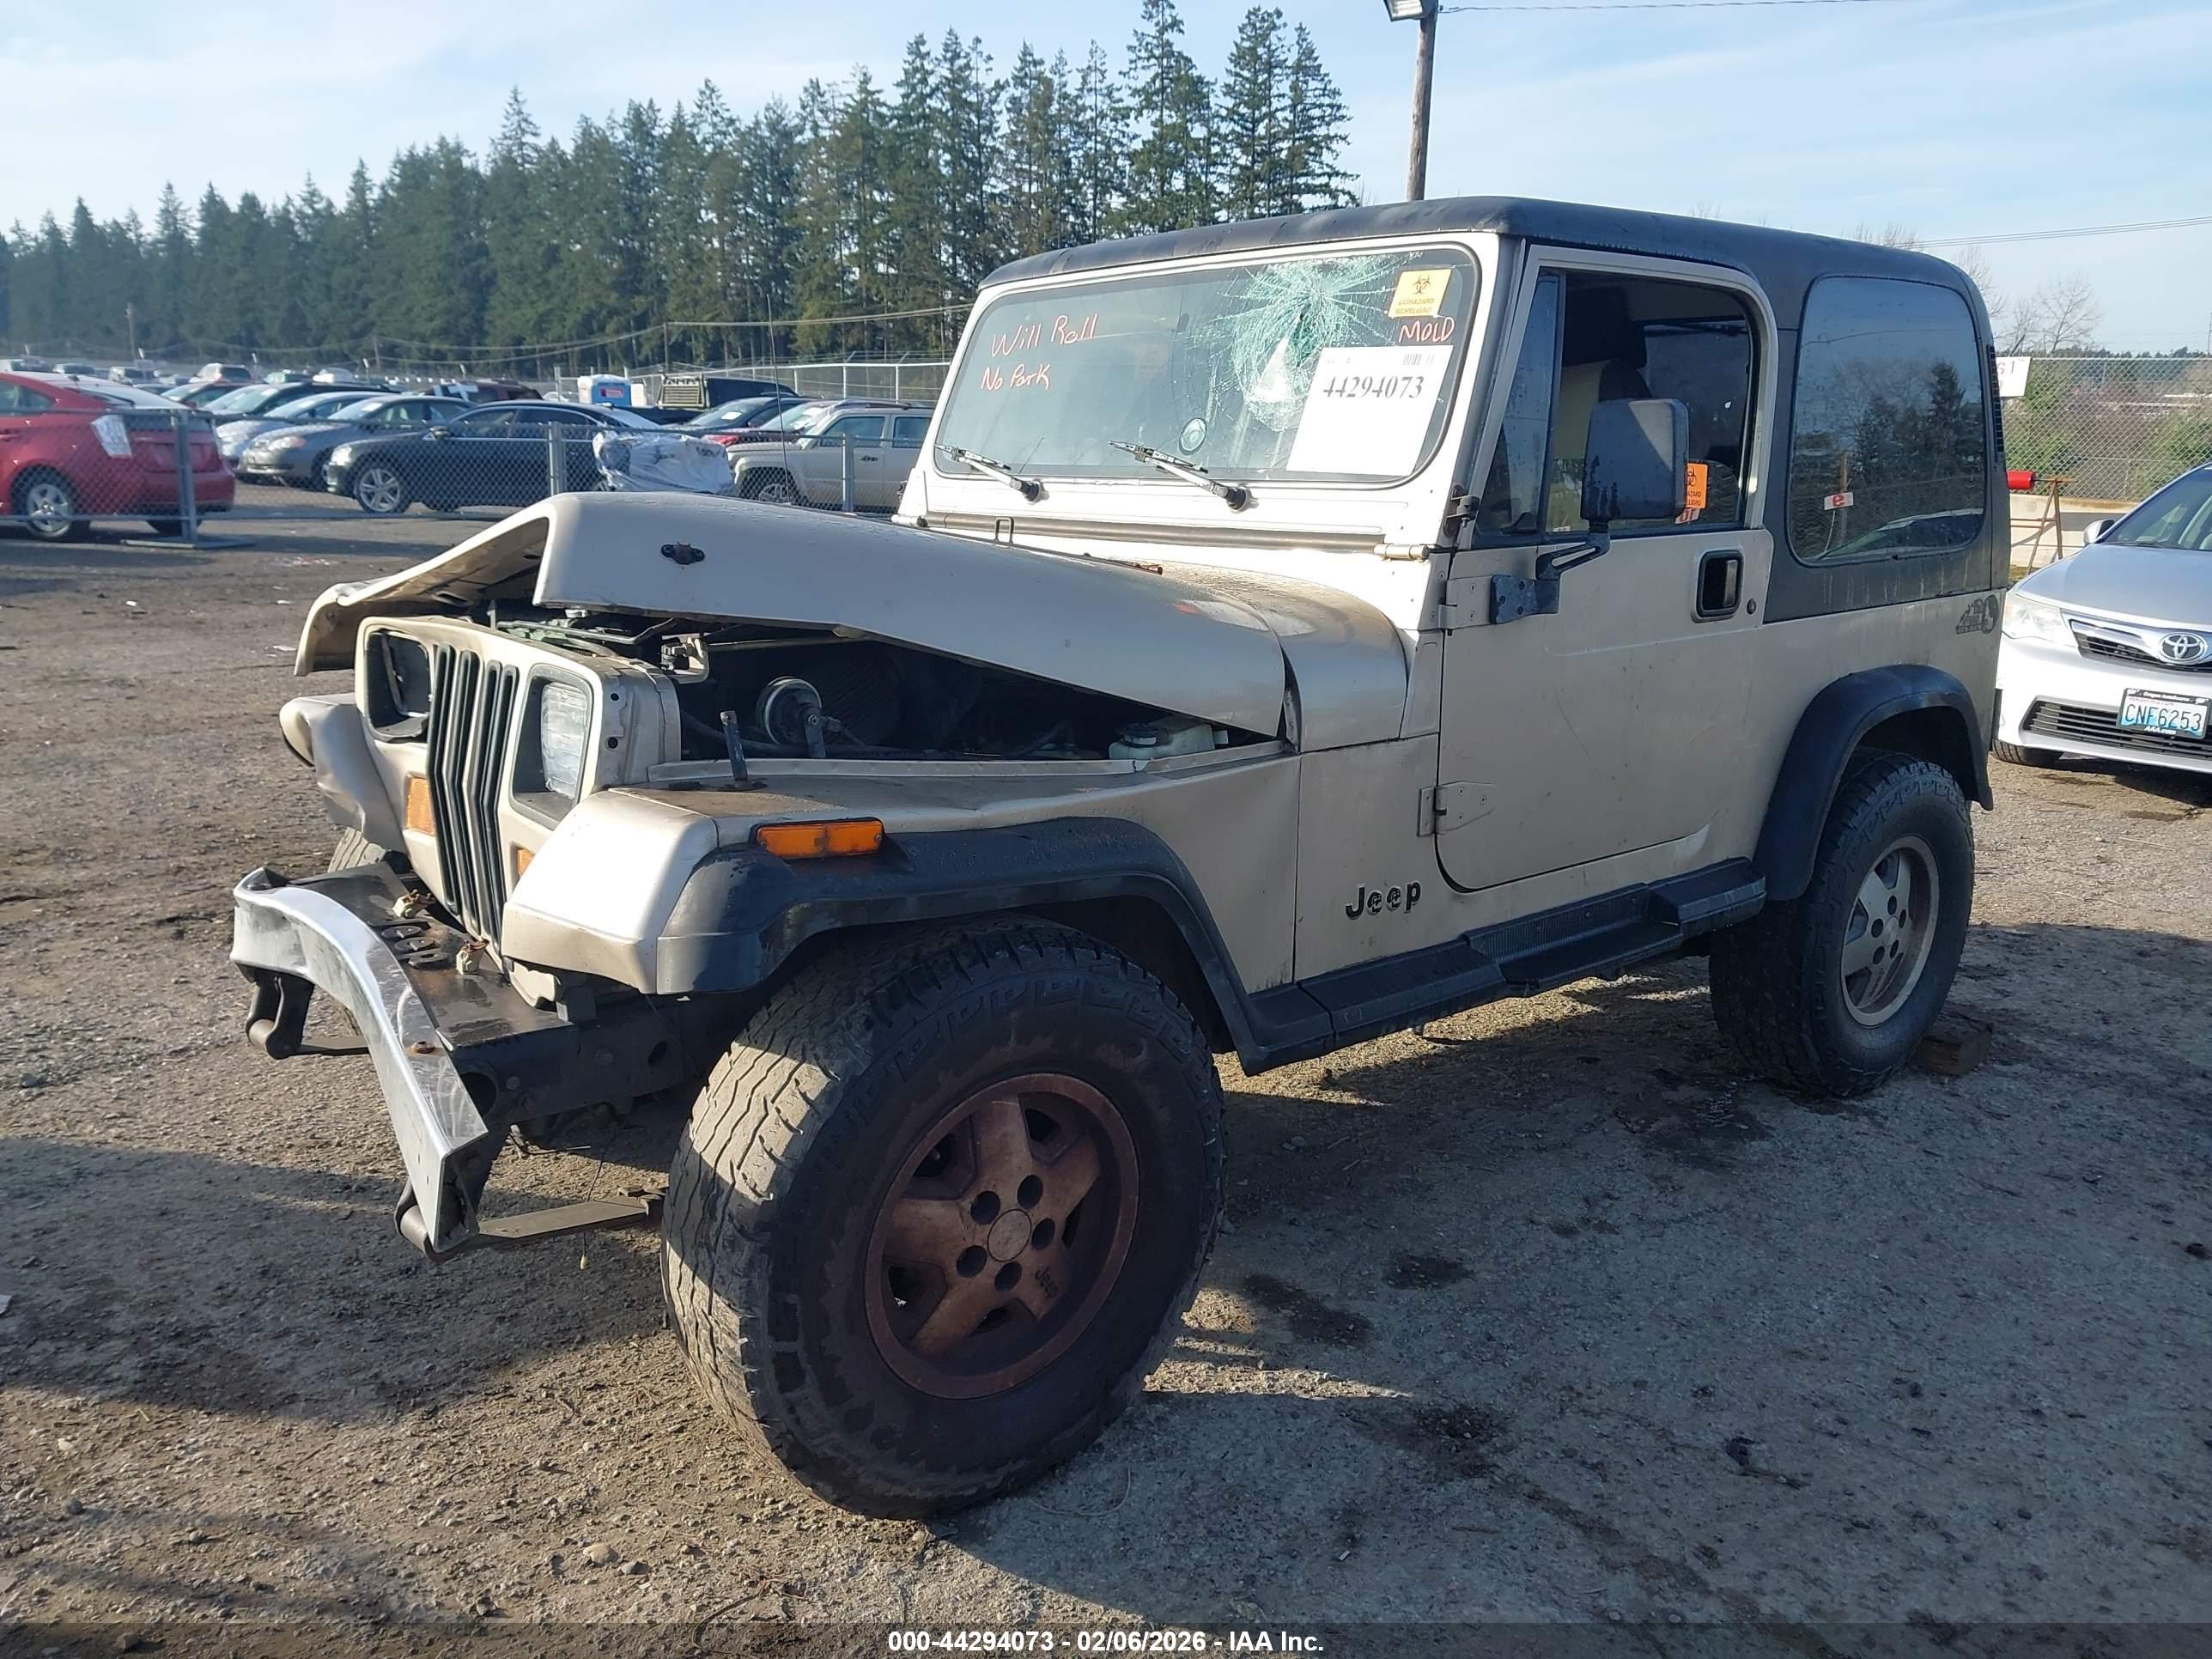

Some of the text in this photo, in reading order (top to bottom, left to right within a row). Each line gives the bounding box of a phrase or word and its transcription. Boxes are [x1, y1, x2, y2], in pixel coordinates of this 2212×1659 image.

[991, 313, 1098, 357] Will Roll
[1398, 316, 1455, 343] MOLD
[981, 367, 1004, 391] No
[1322, 375, 1425, 398] 44294073
[2124, 703, 2203, 732] CNF6253
[1346, 882, 1422, 920] Jeep
